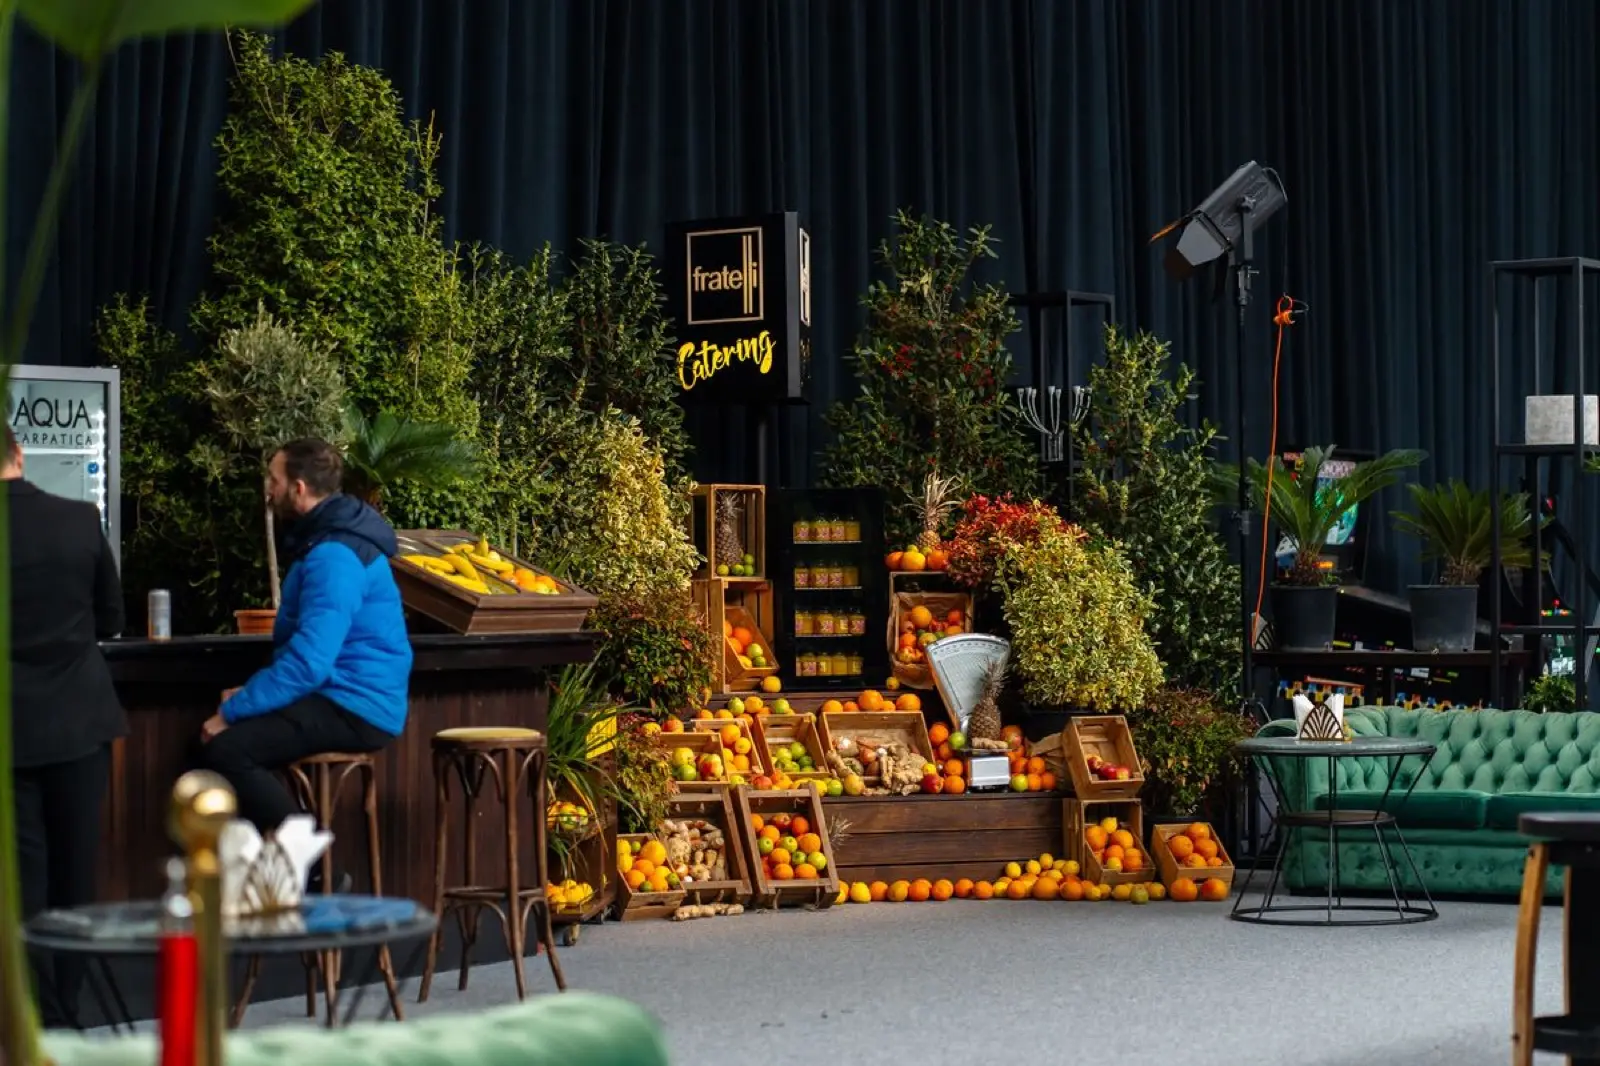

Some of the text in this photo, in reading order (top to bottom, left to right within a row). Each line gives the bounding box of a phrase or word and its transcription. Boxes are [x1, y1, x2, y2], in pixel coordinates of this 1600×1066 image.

[692, 235, 758, 314] fratelli
[677, 330, 777, 390] Catering
[12, 397, 92, 429] AQUA
